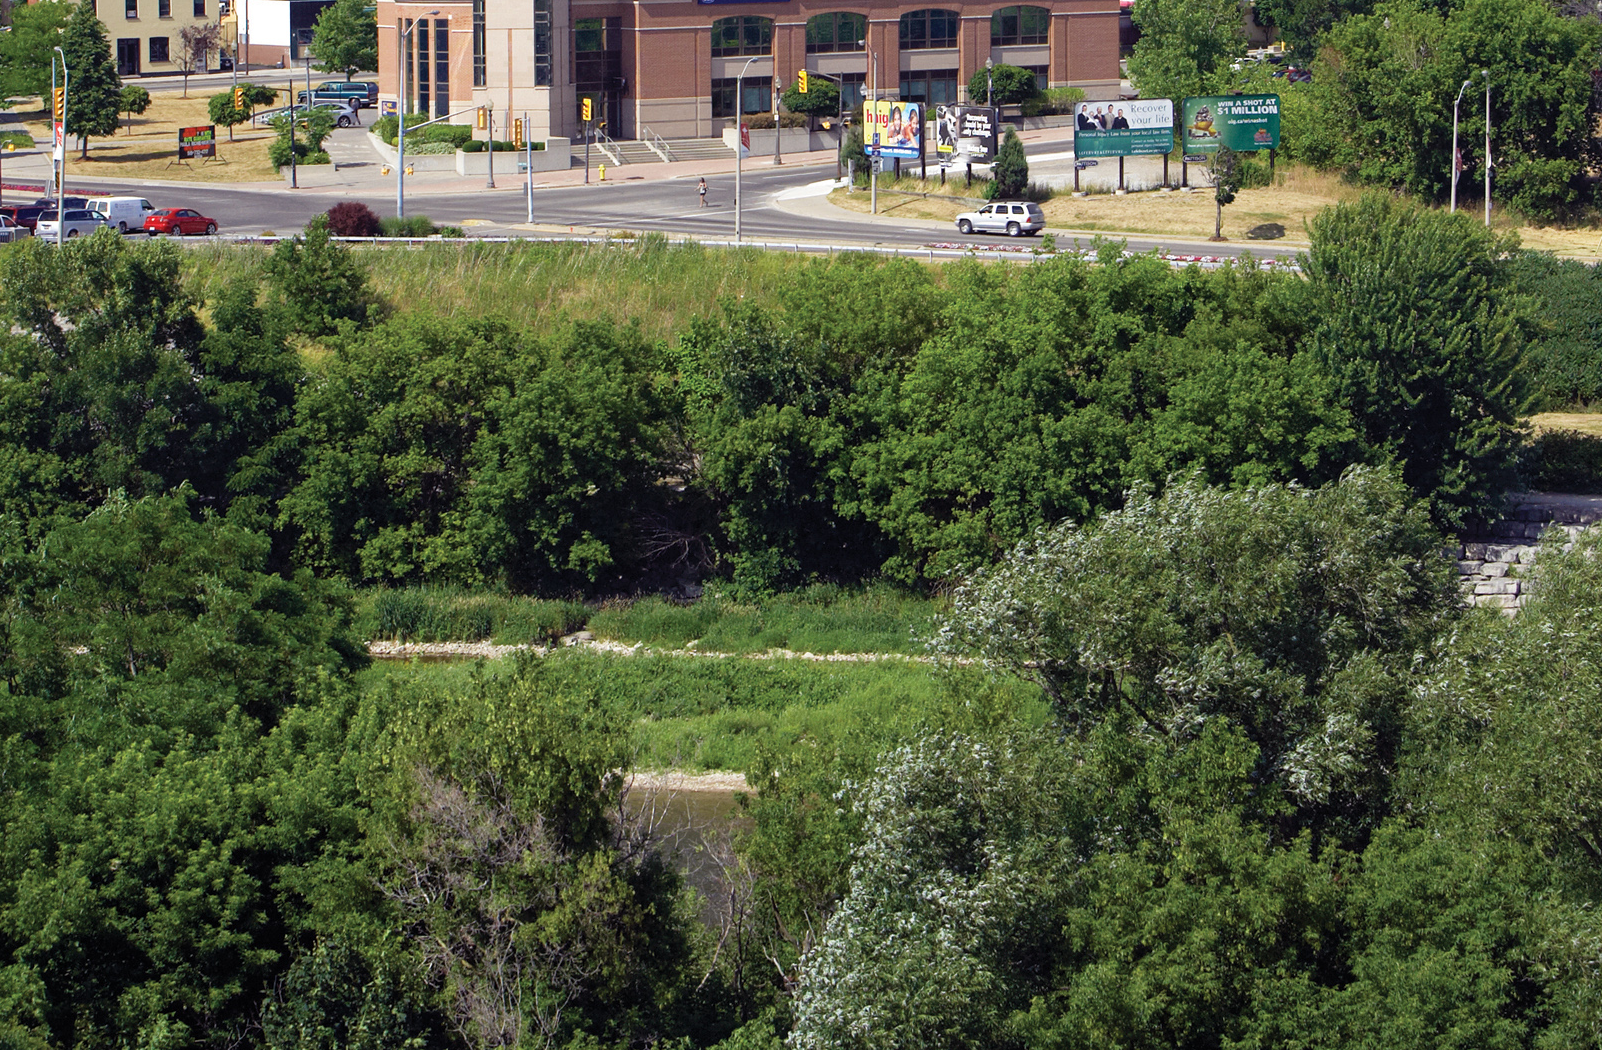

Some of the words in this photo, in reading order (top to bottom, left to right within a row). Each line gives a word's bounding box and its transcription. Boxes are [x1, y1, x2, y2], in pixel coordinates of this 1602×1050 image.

[1131, 104, 1166, 112] Recover
[1217, 107, 1229, 115] $1
[1231, 105, 1278, 114] MILLION
[1131, 116, 1151, 125] your
[1155, 114, 1171, 123] life.
